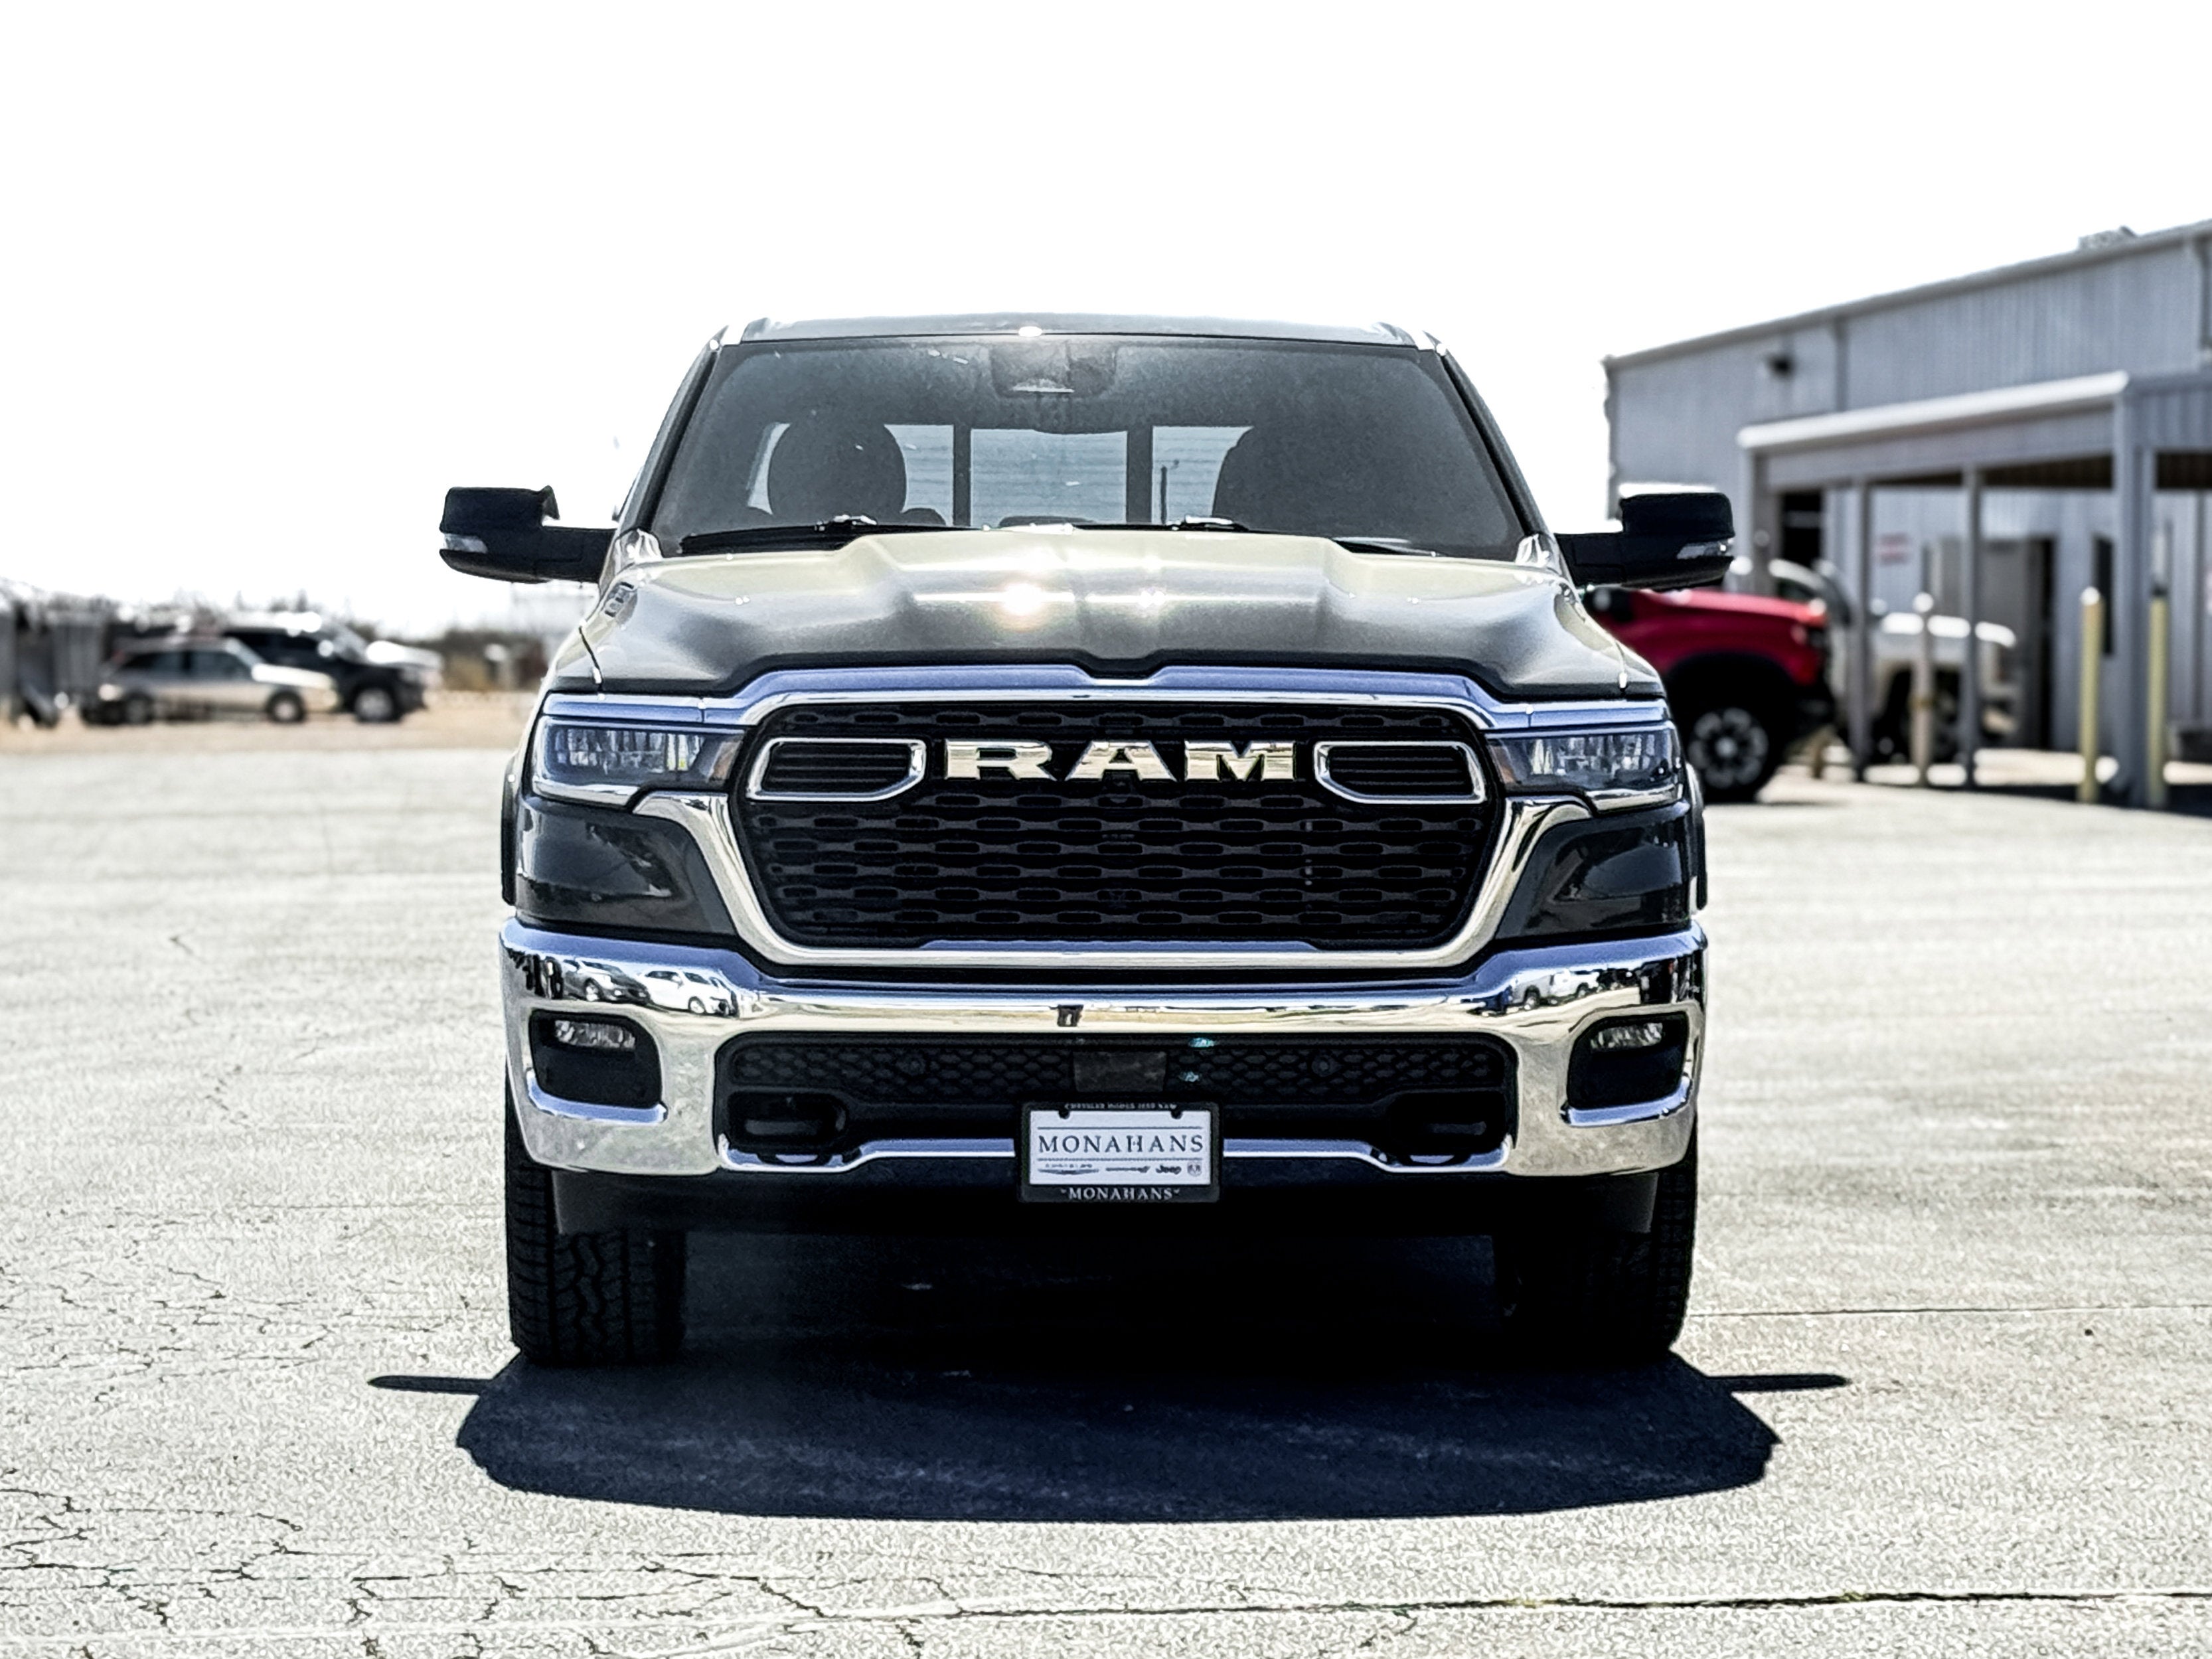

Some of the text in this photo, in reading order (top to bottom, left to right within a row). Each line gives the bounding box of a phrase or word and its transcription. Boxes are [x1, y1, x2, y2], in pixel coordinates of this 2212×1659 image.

[945, 738, 1297, 781] RAM
[1038, 1135, 1204, 1153] MONAHANS
[1067, 1187, 1173, 1201] MONAHANS
